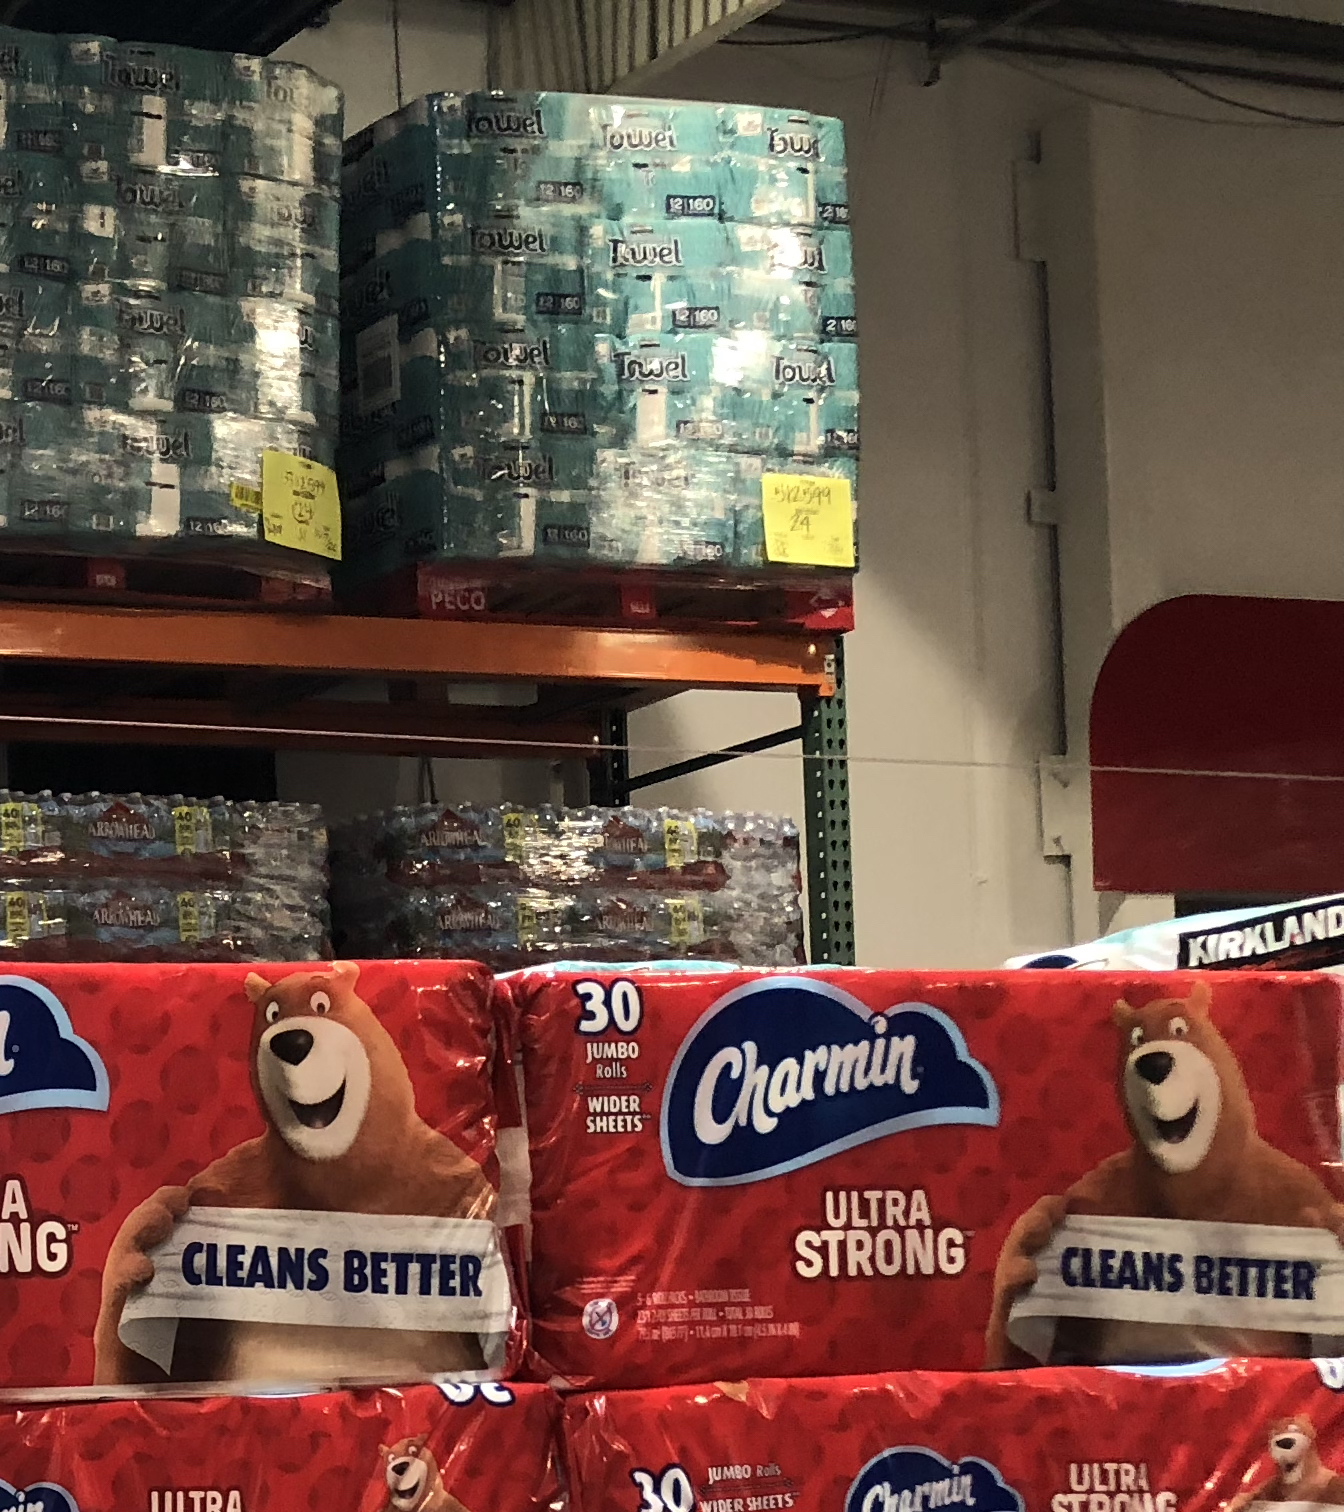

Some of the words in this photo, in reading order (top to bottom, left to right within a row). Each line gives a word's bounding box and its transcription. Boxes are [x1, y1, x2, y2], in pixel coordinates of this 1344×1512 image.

[1188, 905, 1344, 967] KIRKLAND
[575, 978, 642, 1036] 30
[585, 1041, 639, 1062] JUMBO
[694, 1014, 920, 1144] Charmin
[826, 1191, 931, 1228] ULTRA
[181, 1241, 328, 1291] CLEANS
[343, 1250, 483, 1298] BETTER
[795, 1229, 967, 1278] STRONG
[1061, 1248, 1183, 1293] CLEANS
[1196, 1255, 1318, 1301] BETTER
